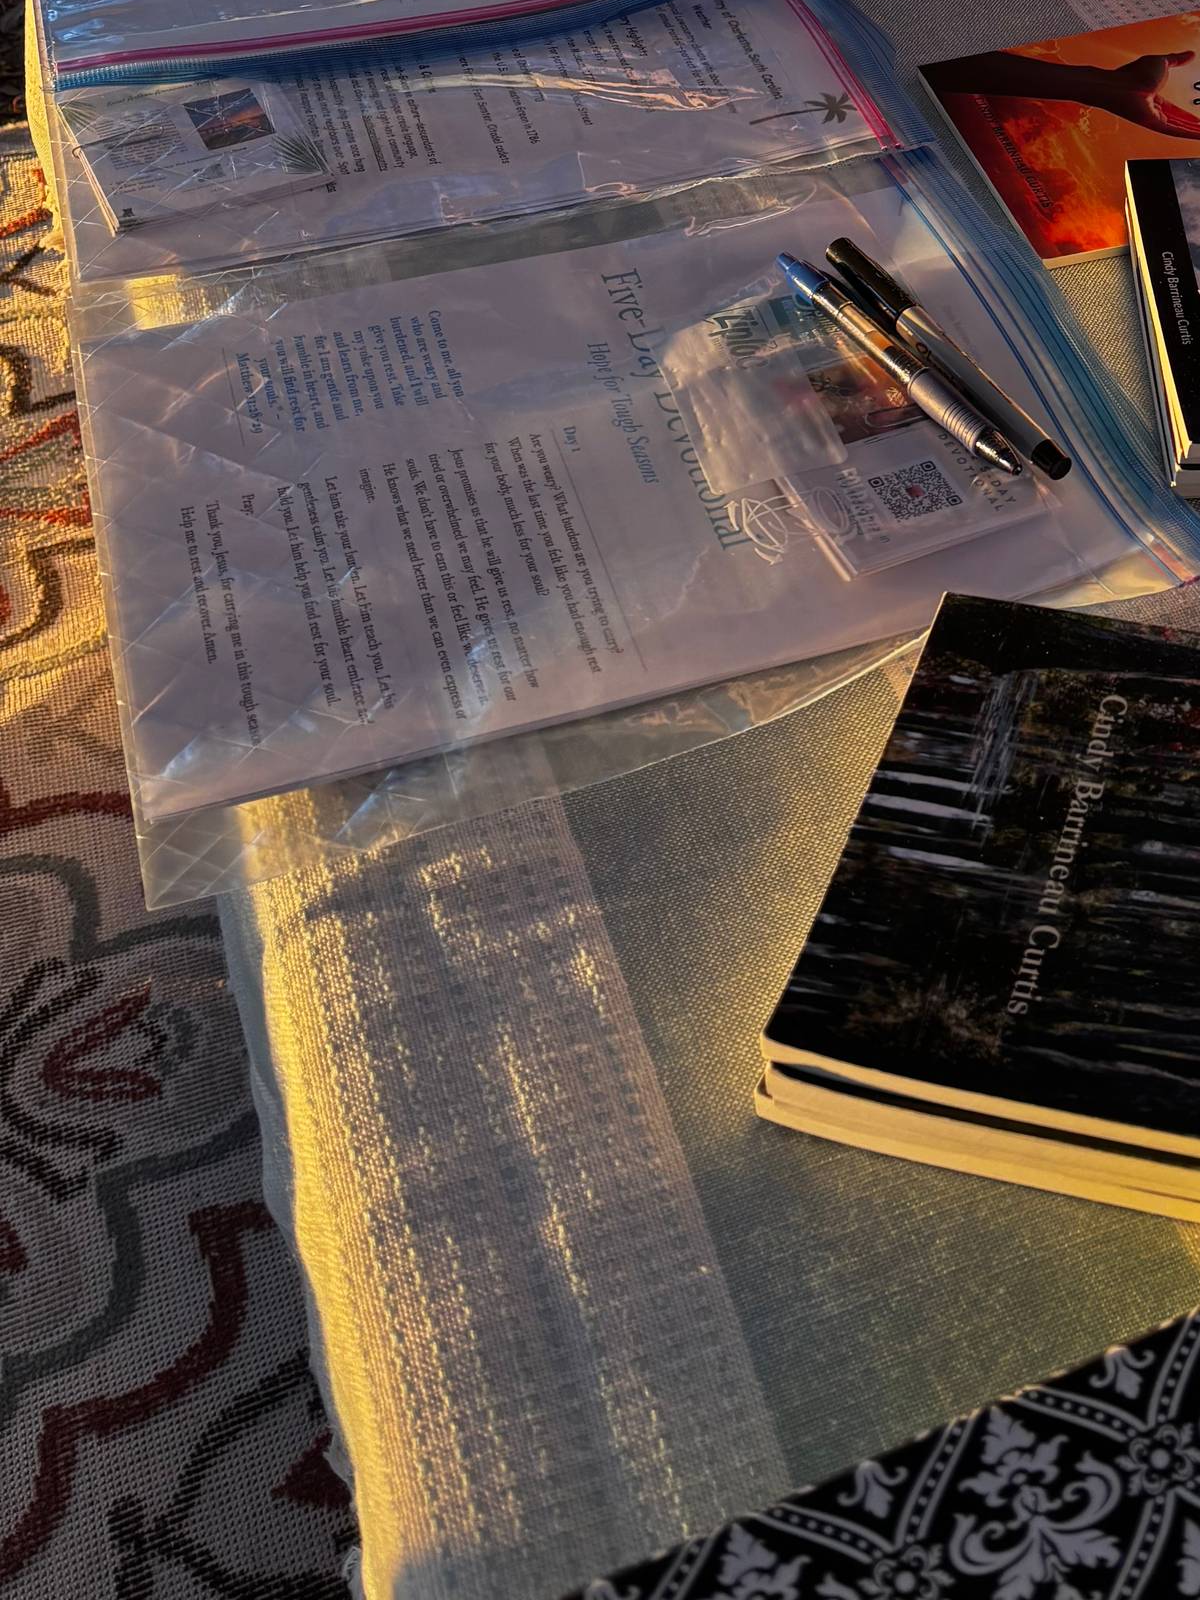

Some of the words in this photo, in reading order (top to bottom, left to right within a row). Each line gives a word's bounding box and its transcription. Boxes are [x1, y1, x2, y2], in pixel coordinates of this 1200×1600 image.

[1161, 251, 1180, 276] Cindy
[1167, 274, 1188, 318] Barrineau
[426, 309, 448, 338] Come
[602, 267, 664, 381] Five-Day
[1179, 317, 1193, 346] Curtis
[436, 338, 449, 349] to
[440, 350, 454, 367] me,
[446, 367, 461, 379] all
[586, 341, 609, 379] Hope
[447, 380, 465, 398] you
[599, 372, 618, 396] for
[608, 395, 637, 441] Tough
[560, 425, 580, 447] Day
[626, 435, 660, 486] Seasons
[1075, 693, 1127, 778] Cindy
[1037, 771, 1106, 921] Barrineau
[1006, 922, 1062, 1018] Curtis
